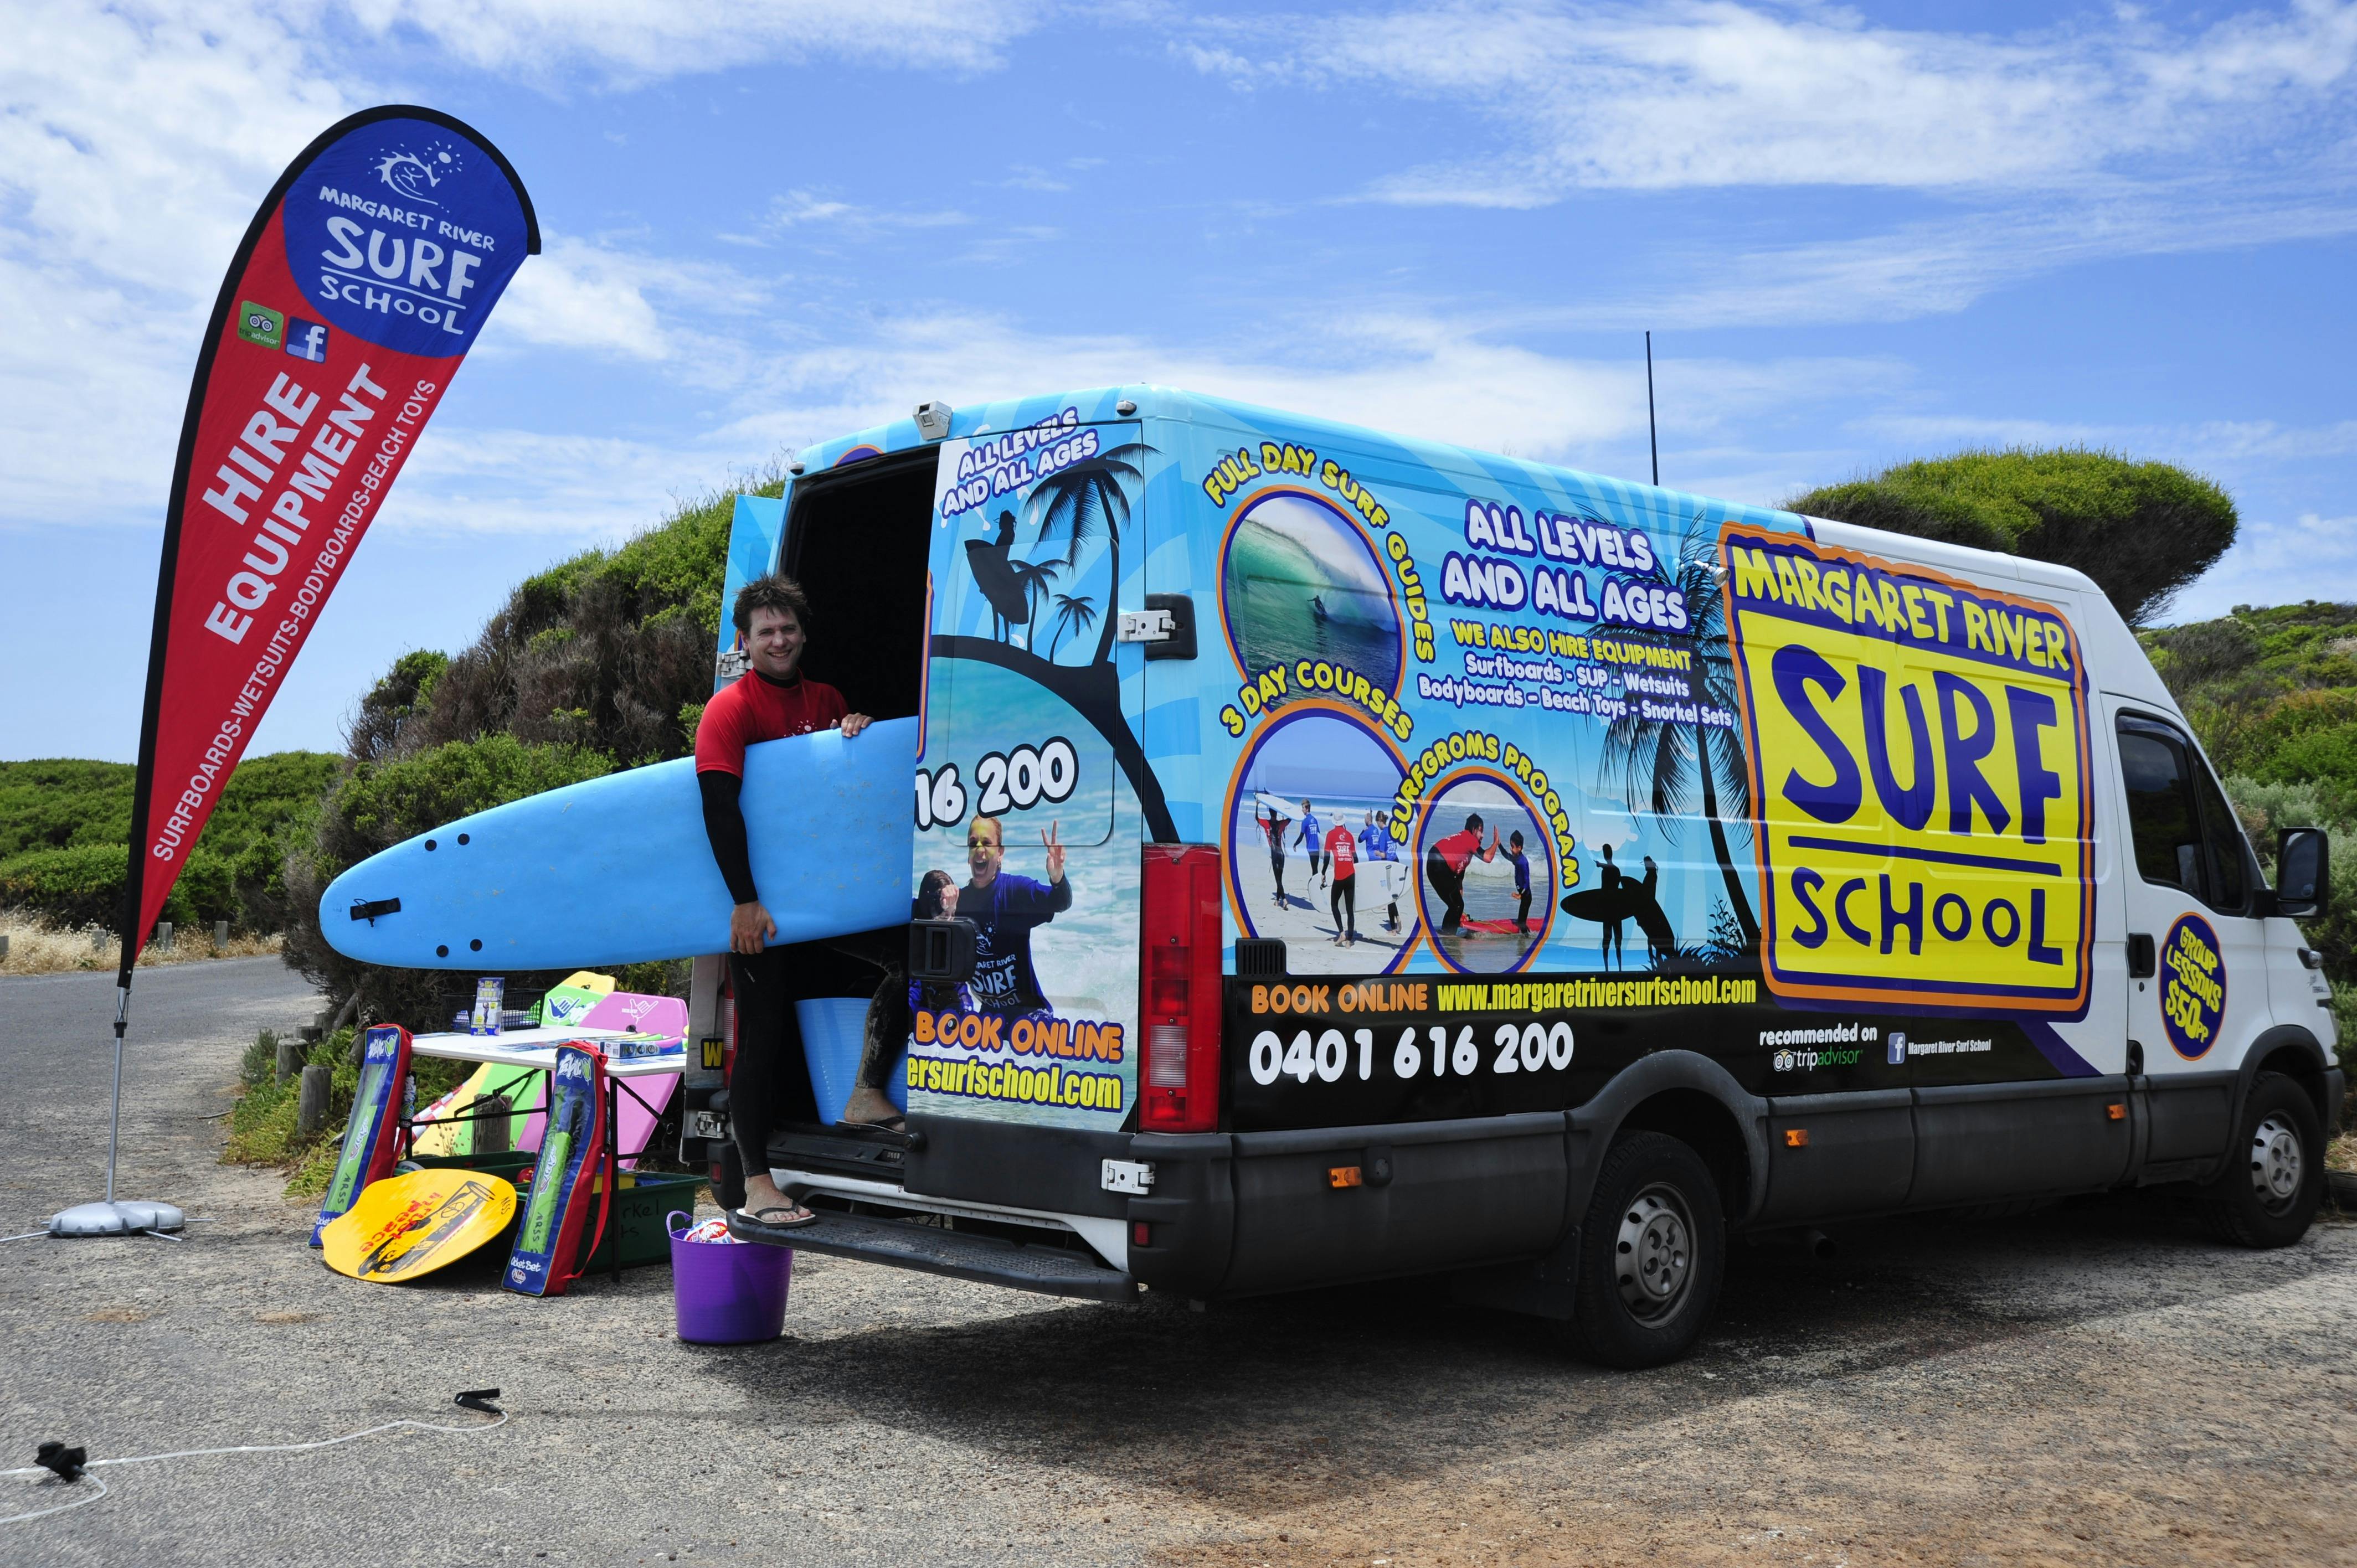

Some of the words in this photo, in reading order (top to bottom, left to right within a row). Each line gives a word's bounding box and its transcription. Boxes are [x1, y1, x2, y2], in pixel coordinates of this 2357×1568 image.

[319, 186, 434, 230] MARGARET
[439, 221, 495, 251] RIVER
[321, 216, 481, 300] SURF
[320, 275, 464, 335] SCHOOL
[396, 380, 436, 434] TOYS
[202, 372, 321, 525] HIRE
[943, 478, 989, 516] AND
[994, 464, 1033, 494] ALL
[1038, 432, 1097, 475] AGES
[959, 443, 997, 479] ALL
[1001, 410, 1078, 460] LEVELS
[204, 363, 387, 644] EQUIPMENT
[1204, 450, 1259, 506] FULL
[1262, 444, 1315, 476] DAY
[1321, 462, 1389, 527] SURF
[1387, 533, 1434, 661] GUIDES
[1468, 504, 1534, 552] ALL
[1537, 515, 1653, 572] LEVELS
[1443, 557, 1525, 606] AND
[1535, 571, 1596, 617] ALL
[1603, 582, 1687, 630] AGES
[1731, 546, 1953, 643] MARGARET
[1962, 599, 2071, 672] RIVER
[1452, 621, 1486, 646] WE
[1491, 628, 1545, 653] ALSO
[1549, 632, 1589, 659] HIRE
[1592, 639, 1691, 672] EQUIPMENT
[1465, 653, 1563, 682] Surfboards
[1576, 667, 1608, 689] SUP
[1623, 672, 1690, 698] Wetsuits
[1221, 707, 1243, 735] 3
[1240, 666, 1288, 715] DAY
[1296, 662, 1413, 740] COURSES
[1418, 677, 1524, 708] Bodyboards
[1541, 689, 1590, 713] Beach
[1592, 694, 1627, 720] Toys
[1642, 700, 1699, 724] Snorkel
[1701, 706, 1733, 728] Sets
[1771, 643, 2061, 844] SURF
[978, 741, 1075, 814] 200
[1390, 733, 1499, 843] SURFGROMS
[1503, 746, 1578, 887] PROGRAM
[1790, 866, 2063, 966] SCHOOL
[996, 954, 1016, 967] RIVER
[2166, 944, 2222, 1013] LESSONS
[2179, 925, 2218, 976] GROUP
[982, 992, 1021, 1009] CHOOL
[1251, 985, 1330, 1014] BOOK
[1337, 983, 1428, 1013] ONLINE
[1437, 975, 1757, 1014] www.margaretriversurfschool.com
[915, 1011, 1002, 1050] BOOK
[1011, 1018, 1124, 1061] ONLINE
[1249, 1028, 1373, 1086] 0401
[1393, 1025, 1479, 1079] 616
[1493, 1021, 1574, 1074] 200
[1759, 1022, 1859, 1046] recommended
[1861, 1026, 1878, 1041] on
[1797, 1045, 1860, 1072] tripadvisor
[1907, 1041, 1938, 1056] Margaret
[1938, 1041, 1955, 1054] River
[1955, 1039, 1970, 1053] Surf
[1969, 1039, 1991, 1052] School
[526, 1260, 542, 1272] Set
